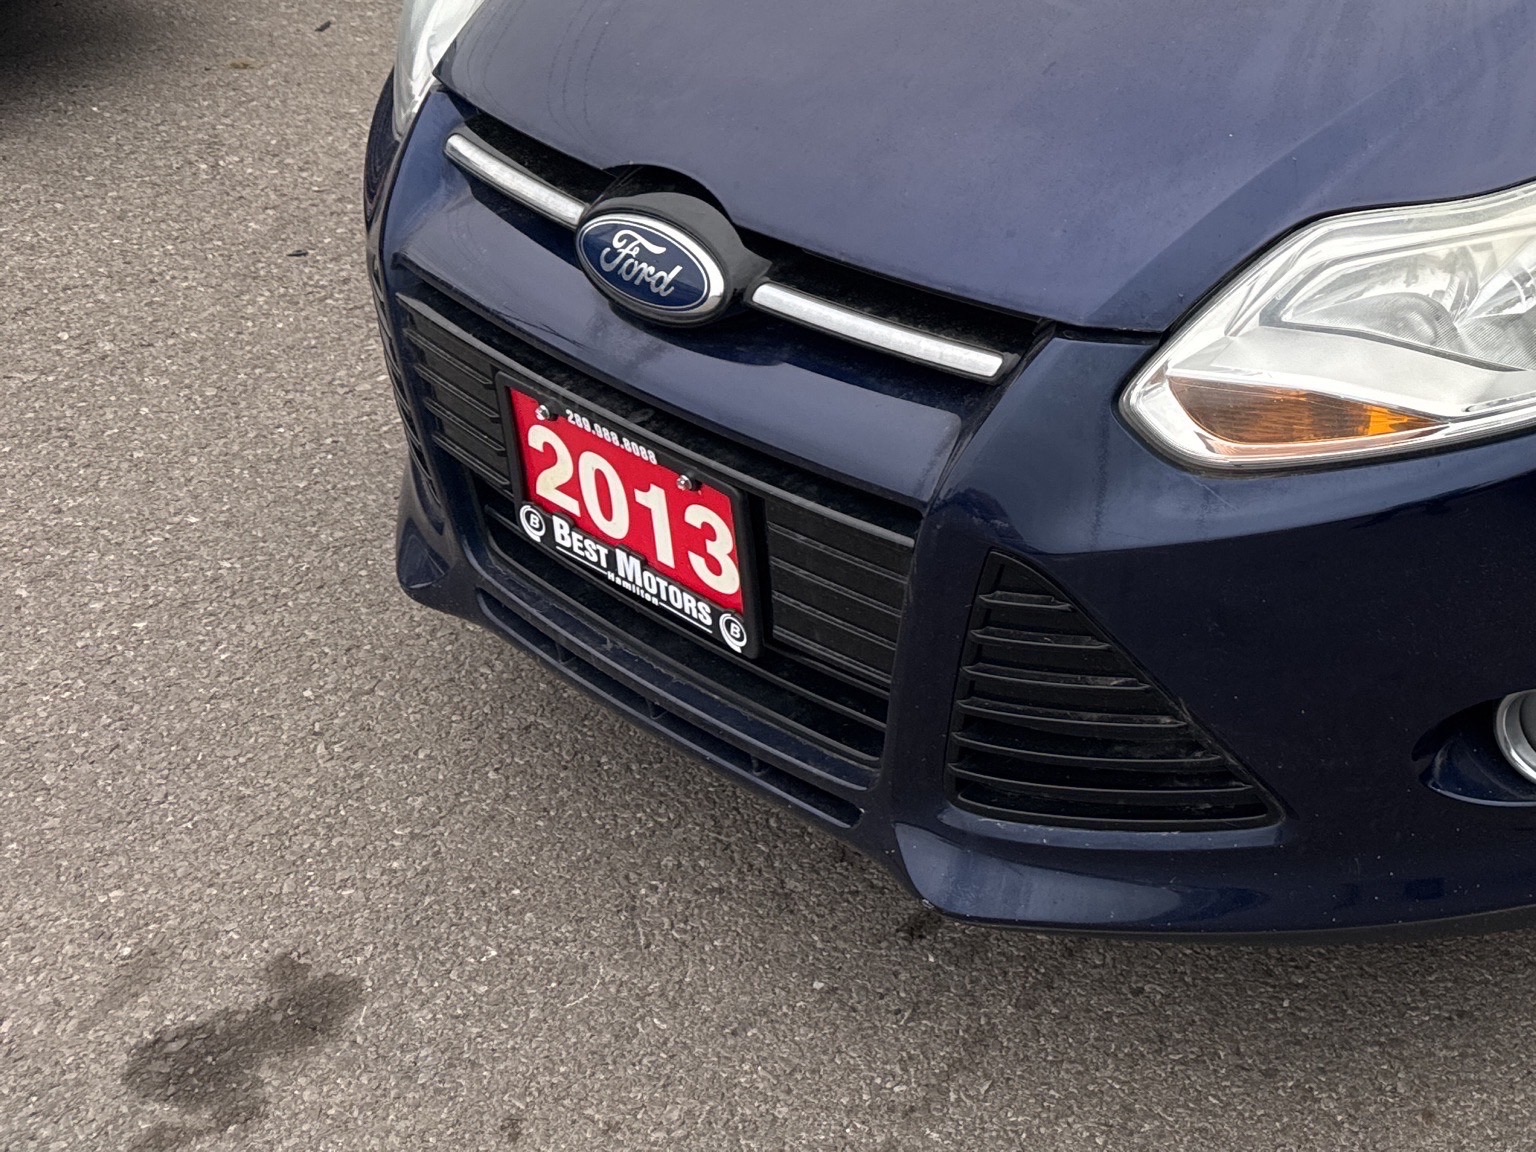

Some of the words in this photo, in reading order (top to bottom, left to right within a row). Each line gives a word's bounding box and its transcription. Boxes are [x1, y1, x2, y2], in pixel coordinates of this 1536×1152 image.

[600, 228, 683, 297] Ford
[565, 408, 658, 466] 289.988.8088
[527, 424, 741, 596] 2013
[607, 570, 660, 606] Hamilton
